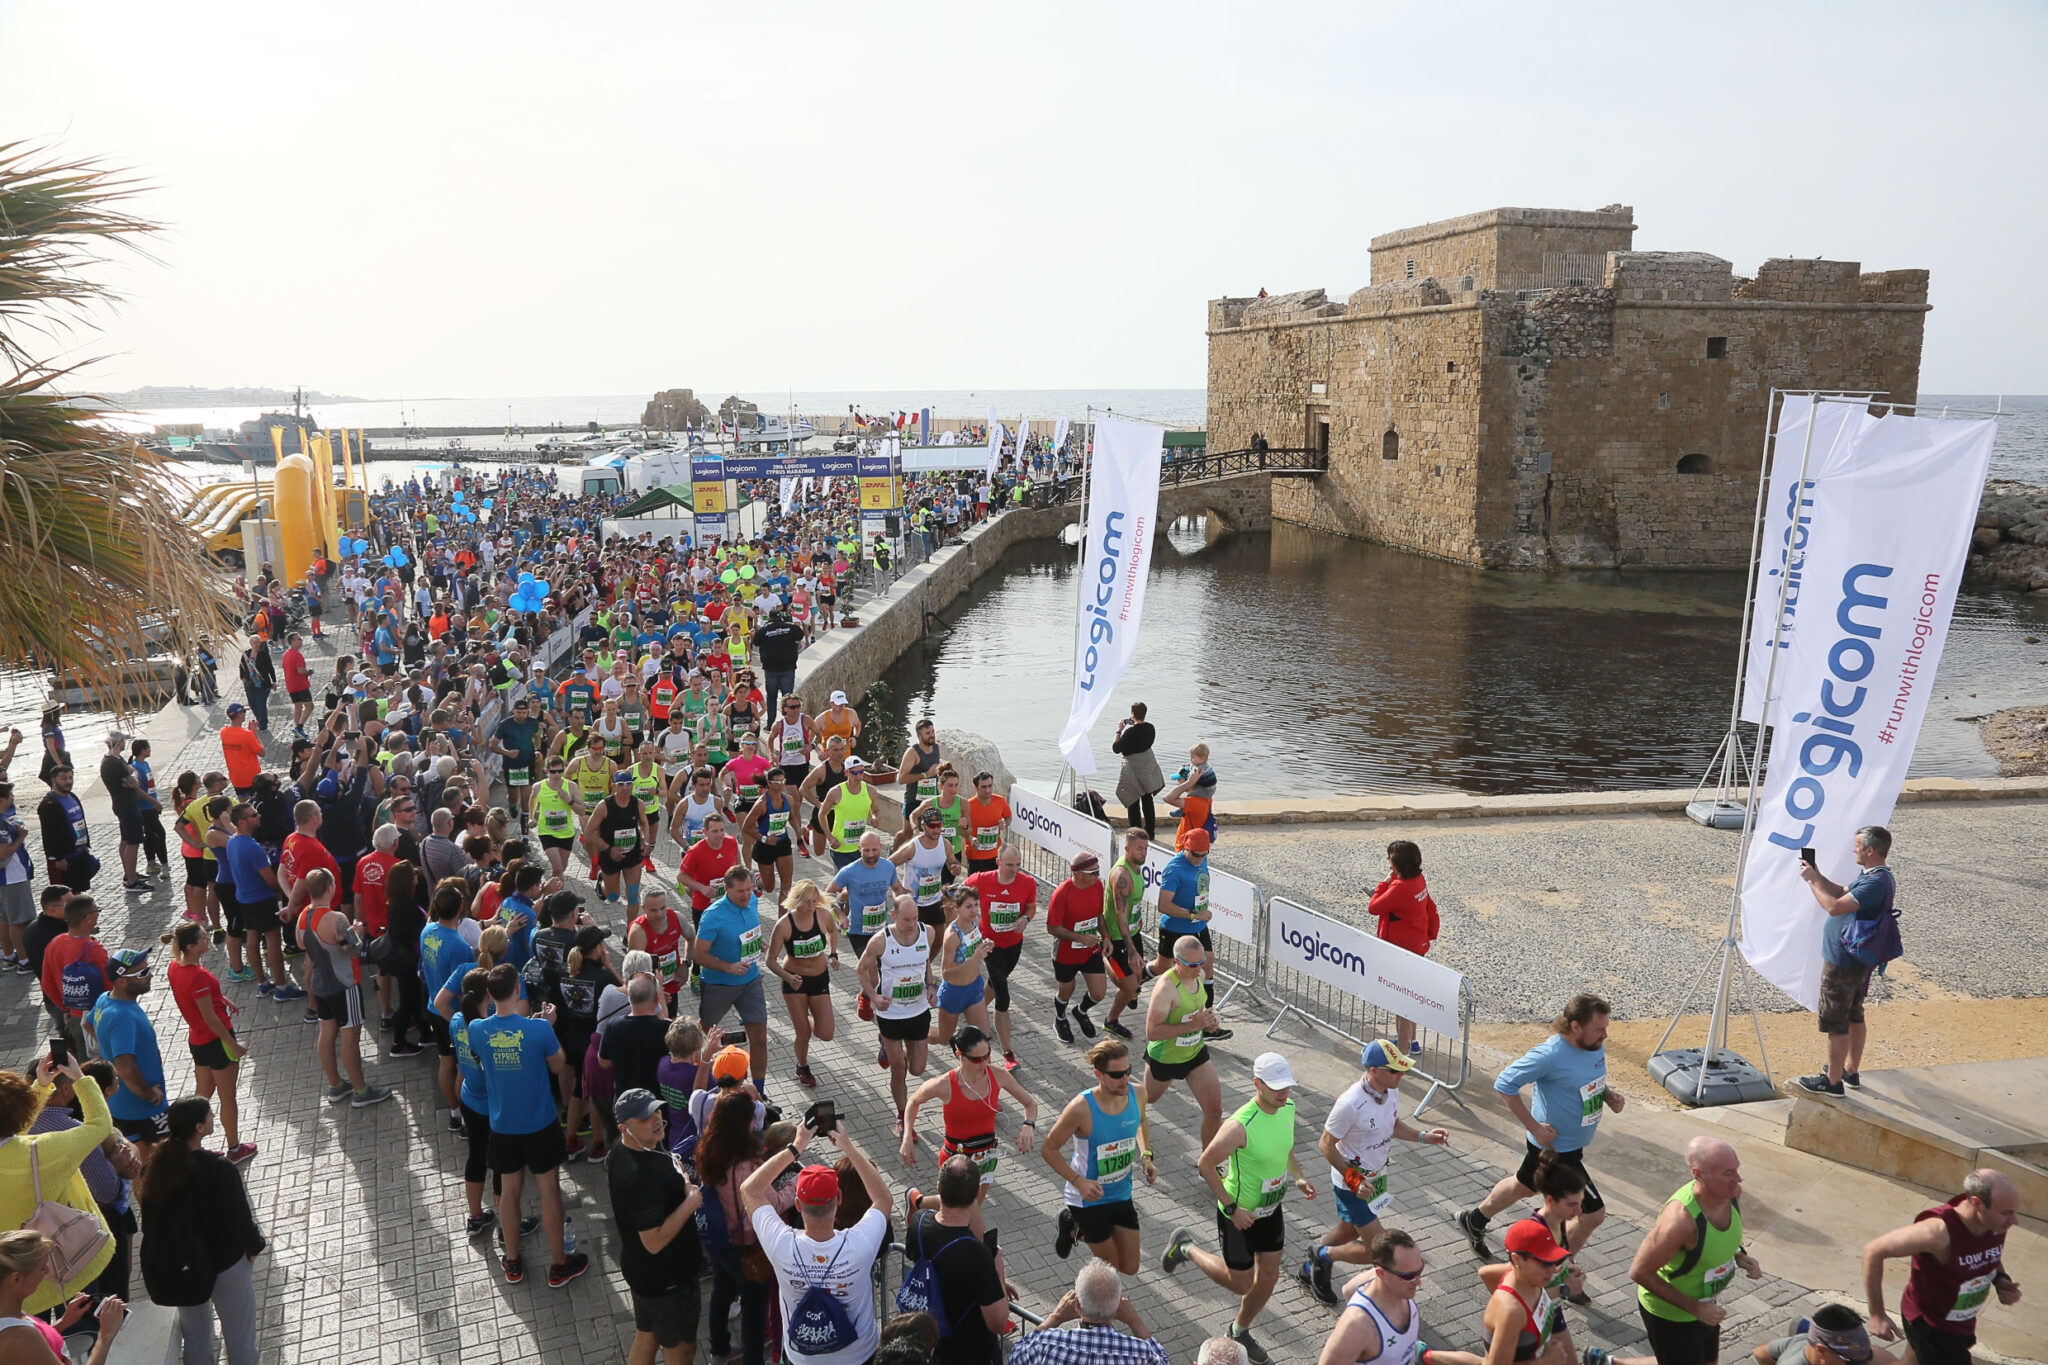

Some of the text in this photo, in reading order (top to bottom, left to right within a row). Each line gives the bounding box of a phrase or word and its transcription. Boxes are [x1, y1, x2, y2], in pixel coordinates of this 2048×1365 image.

[695, 468, 720, 476] Logicom
[726, 464, 757, 474] Logicom
[821, 461, 853, 471] Logicom
[862, 463, 888, 471] Logicom
[1118, 515, 1145, 622] #runwithlogicom
[1080, 510, 1125, 692] Logicom
[1877, 573, 1941, 745] #runwithlogicom
[1767, 563, 1894, 851] Logicom
[1015, 801, 1063, 839] Logicom
[799, 941, 821, 955] 1492
[1281, 921, 1366, 976] Logicom
[1376, 975, 1445, 1012] #runwithlogicom
[493, 1052, 520, 1060] CYPRUS
[1104, 1153, 1131, 1175] 1730
[1958, 1252, 1984, 1266] LOW
